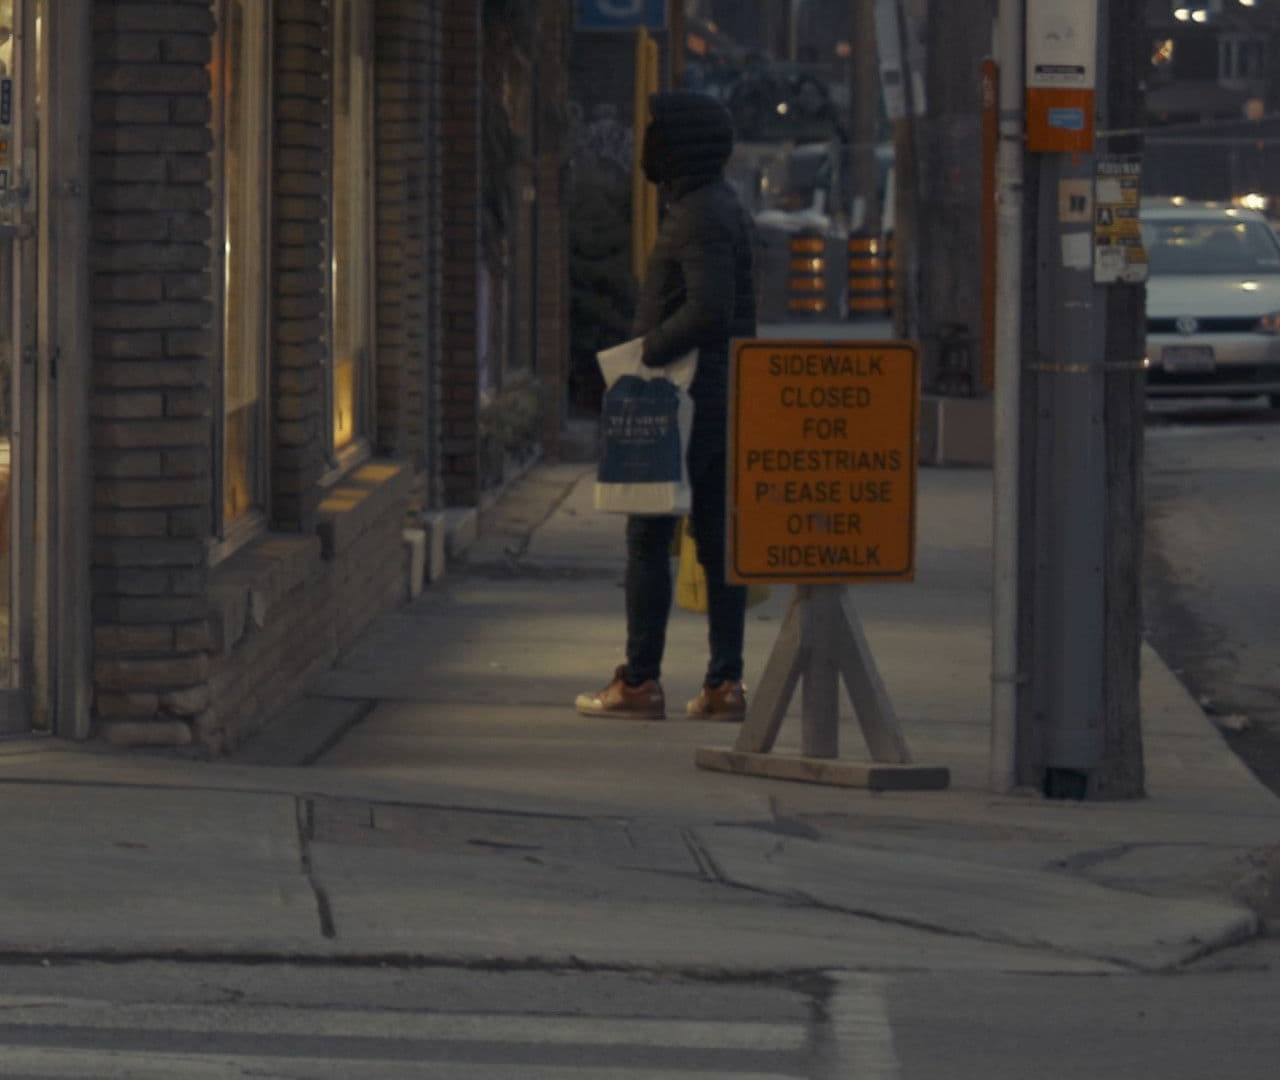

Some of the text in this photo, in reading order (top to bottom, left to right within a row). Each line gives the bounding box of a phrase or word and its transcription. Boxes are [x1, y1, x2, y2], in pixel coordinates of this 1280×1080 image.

[769, 354, 885, 376] SIDEWALK
[780, 386, 871, 408] CLOSED
[803, 418, 848, 440] FOR
[747, 450, 902, 471] PEDESTRIANS
[755, 481, 893, 503] PLEASE USE
[786, 513, 863, 535] OTHER
[767, 545, 881, 567] SIDEWALK
